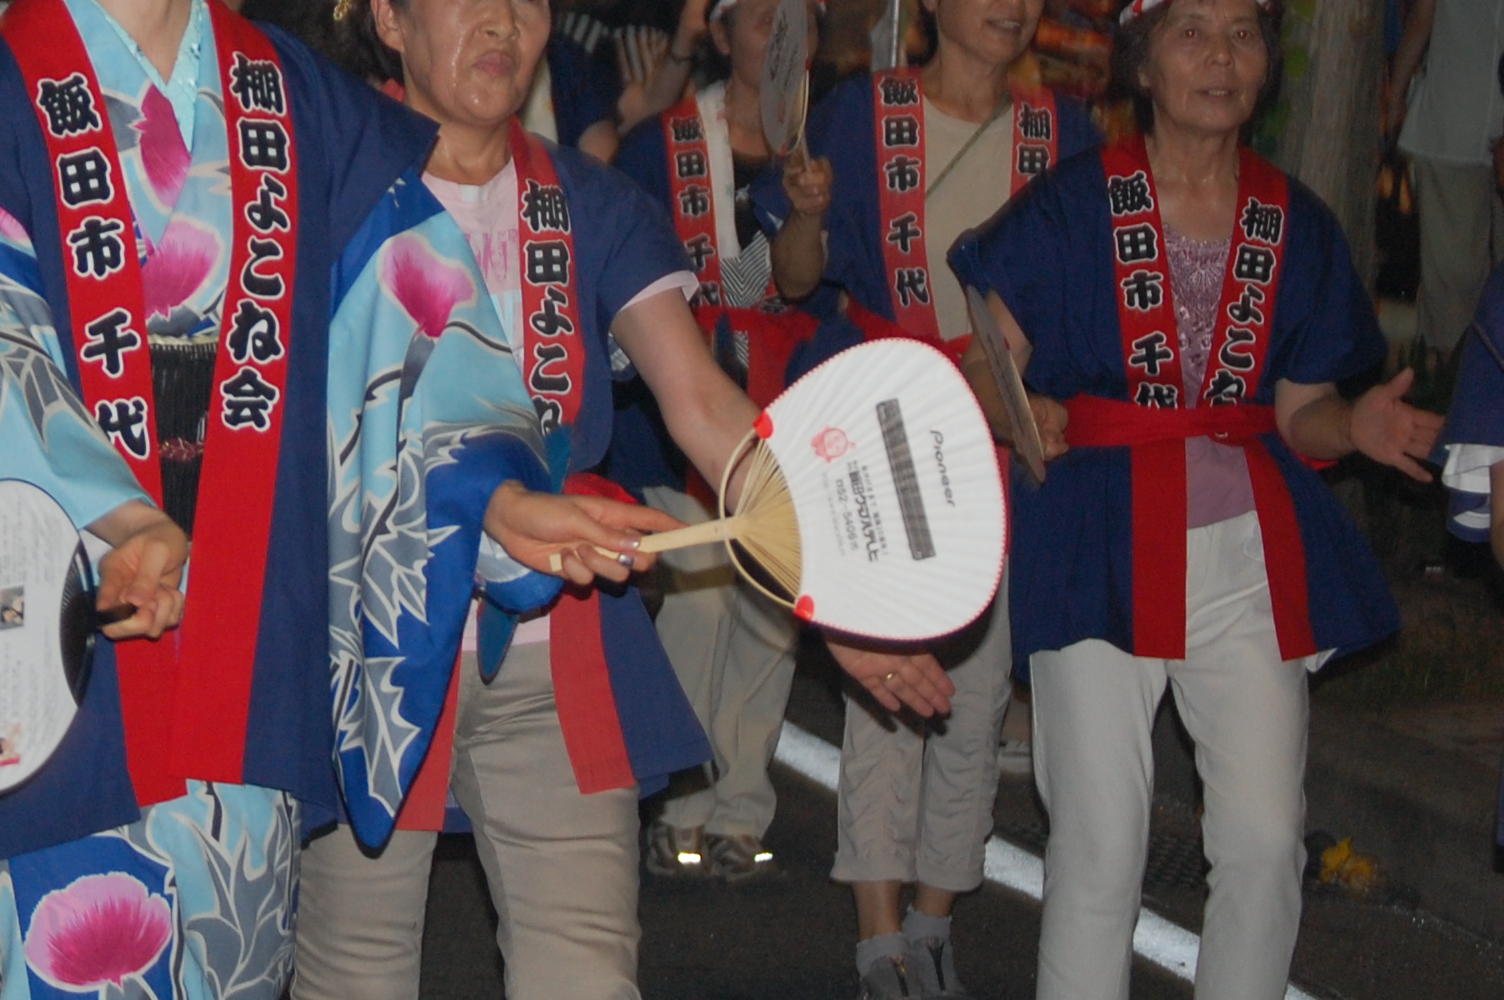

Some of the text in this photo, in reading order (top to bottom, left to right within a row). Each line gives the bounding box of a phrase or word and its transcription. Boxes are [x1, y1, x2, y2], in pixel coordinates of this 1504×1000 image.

[220, 51, 291, 432] 棚田よこね会
[878, 74, 930, 309] 飯田市千代
[930, 429, 955, 508] Pioneer
